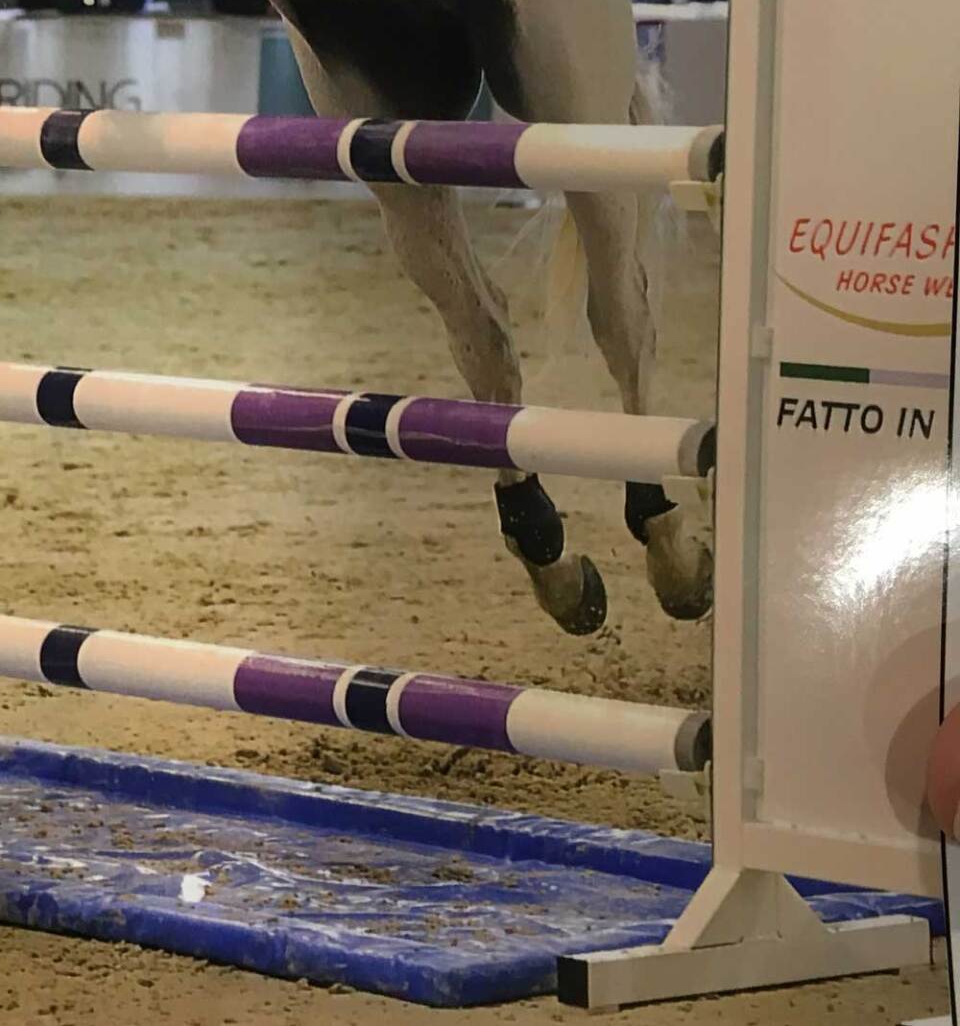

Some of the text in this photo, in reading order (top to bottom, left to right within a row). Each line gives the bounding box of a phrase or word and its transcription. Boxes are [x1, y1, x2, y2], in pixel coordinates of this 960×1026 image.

[836, 270, 915, 295] HORSE
[777, 397, 935, 439] FATTO IN
